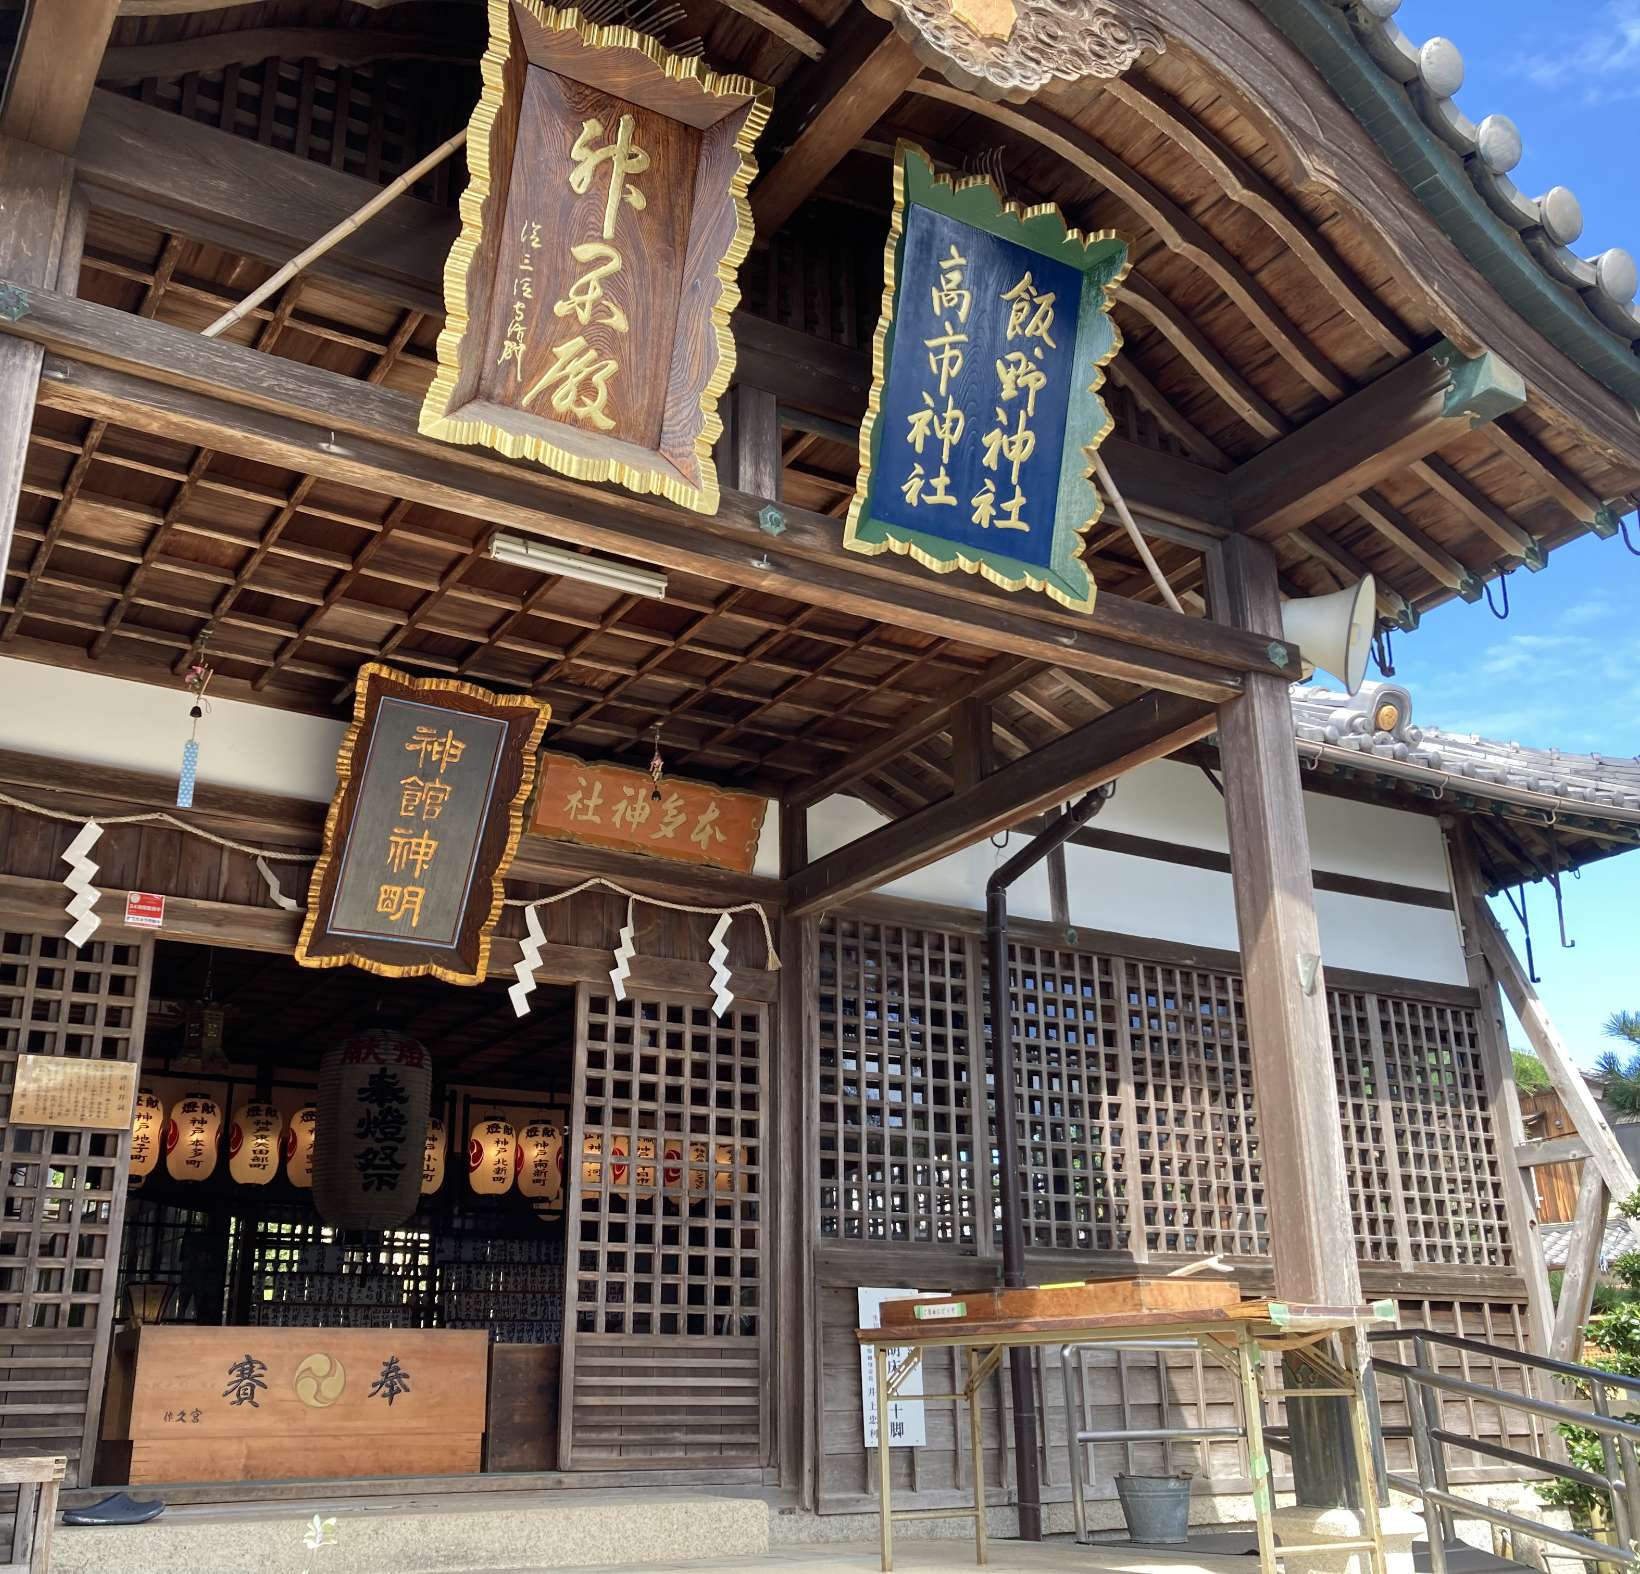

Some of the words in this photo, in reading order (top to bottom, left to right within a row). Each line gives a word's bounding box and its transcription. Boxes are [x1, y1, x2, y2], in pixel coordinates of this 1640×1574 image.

[901, 243, 973, 507] 高市神社
[971, 271, 1057, 533] 飯野神社
[377, 725, 466, 929] 神館神明
[185, 1117, 208, 1168] 神戸本多町
[492, 1138, 509, 1184] 神戸北新町
[532, 1140, 549, 1186] 神戸南新町
[368, 1354, 410, 1406] 奉
